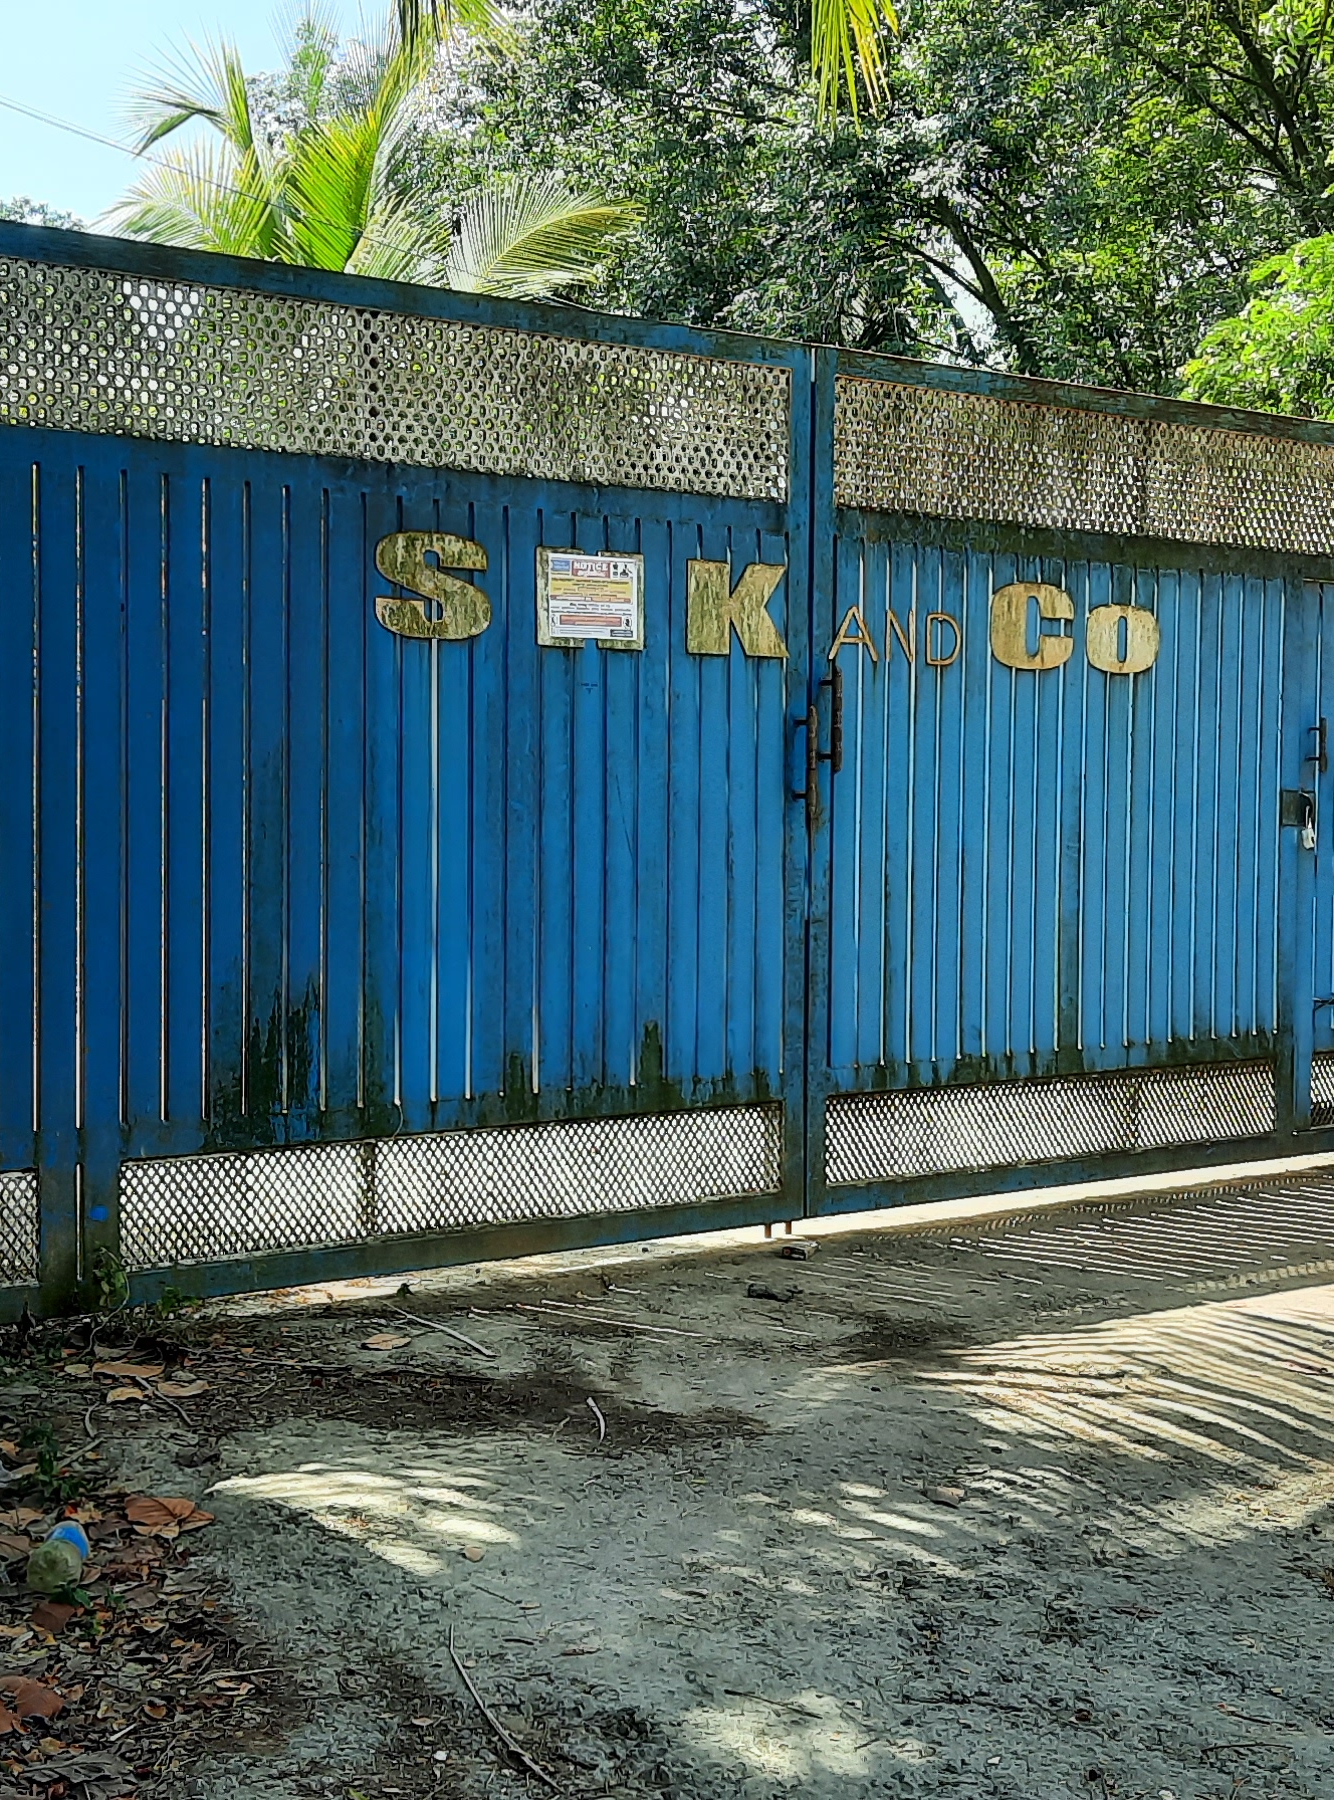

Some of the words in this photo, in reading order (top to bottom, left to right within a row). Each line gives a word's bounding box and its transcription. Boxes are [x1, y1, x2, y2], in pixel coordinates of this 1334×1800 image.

[374, 530, 492, 641] S
[686, 558, 789, 660] K
[827, 604, 962, 667] AND
[989, 581, 1160, 675] Co
